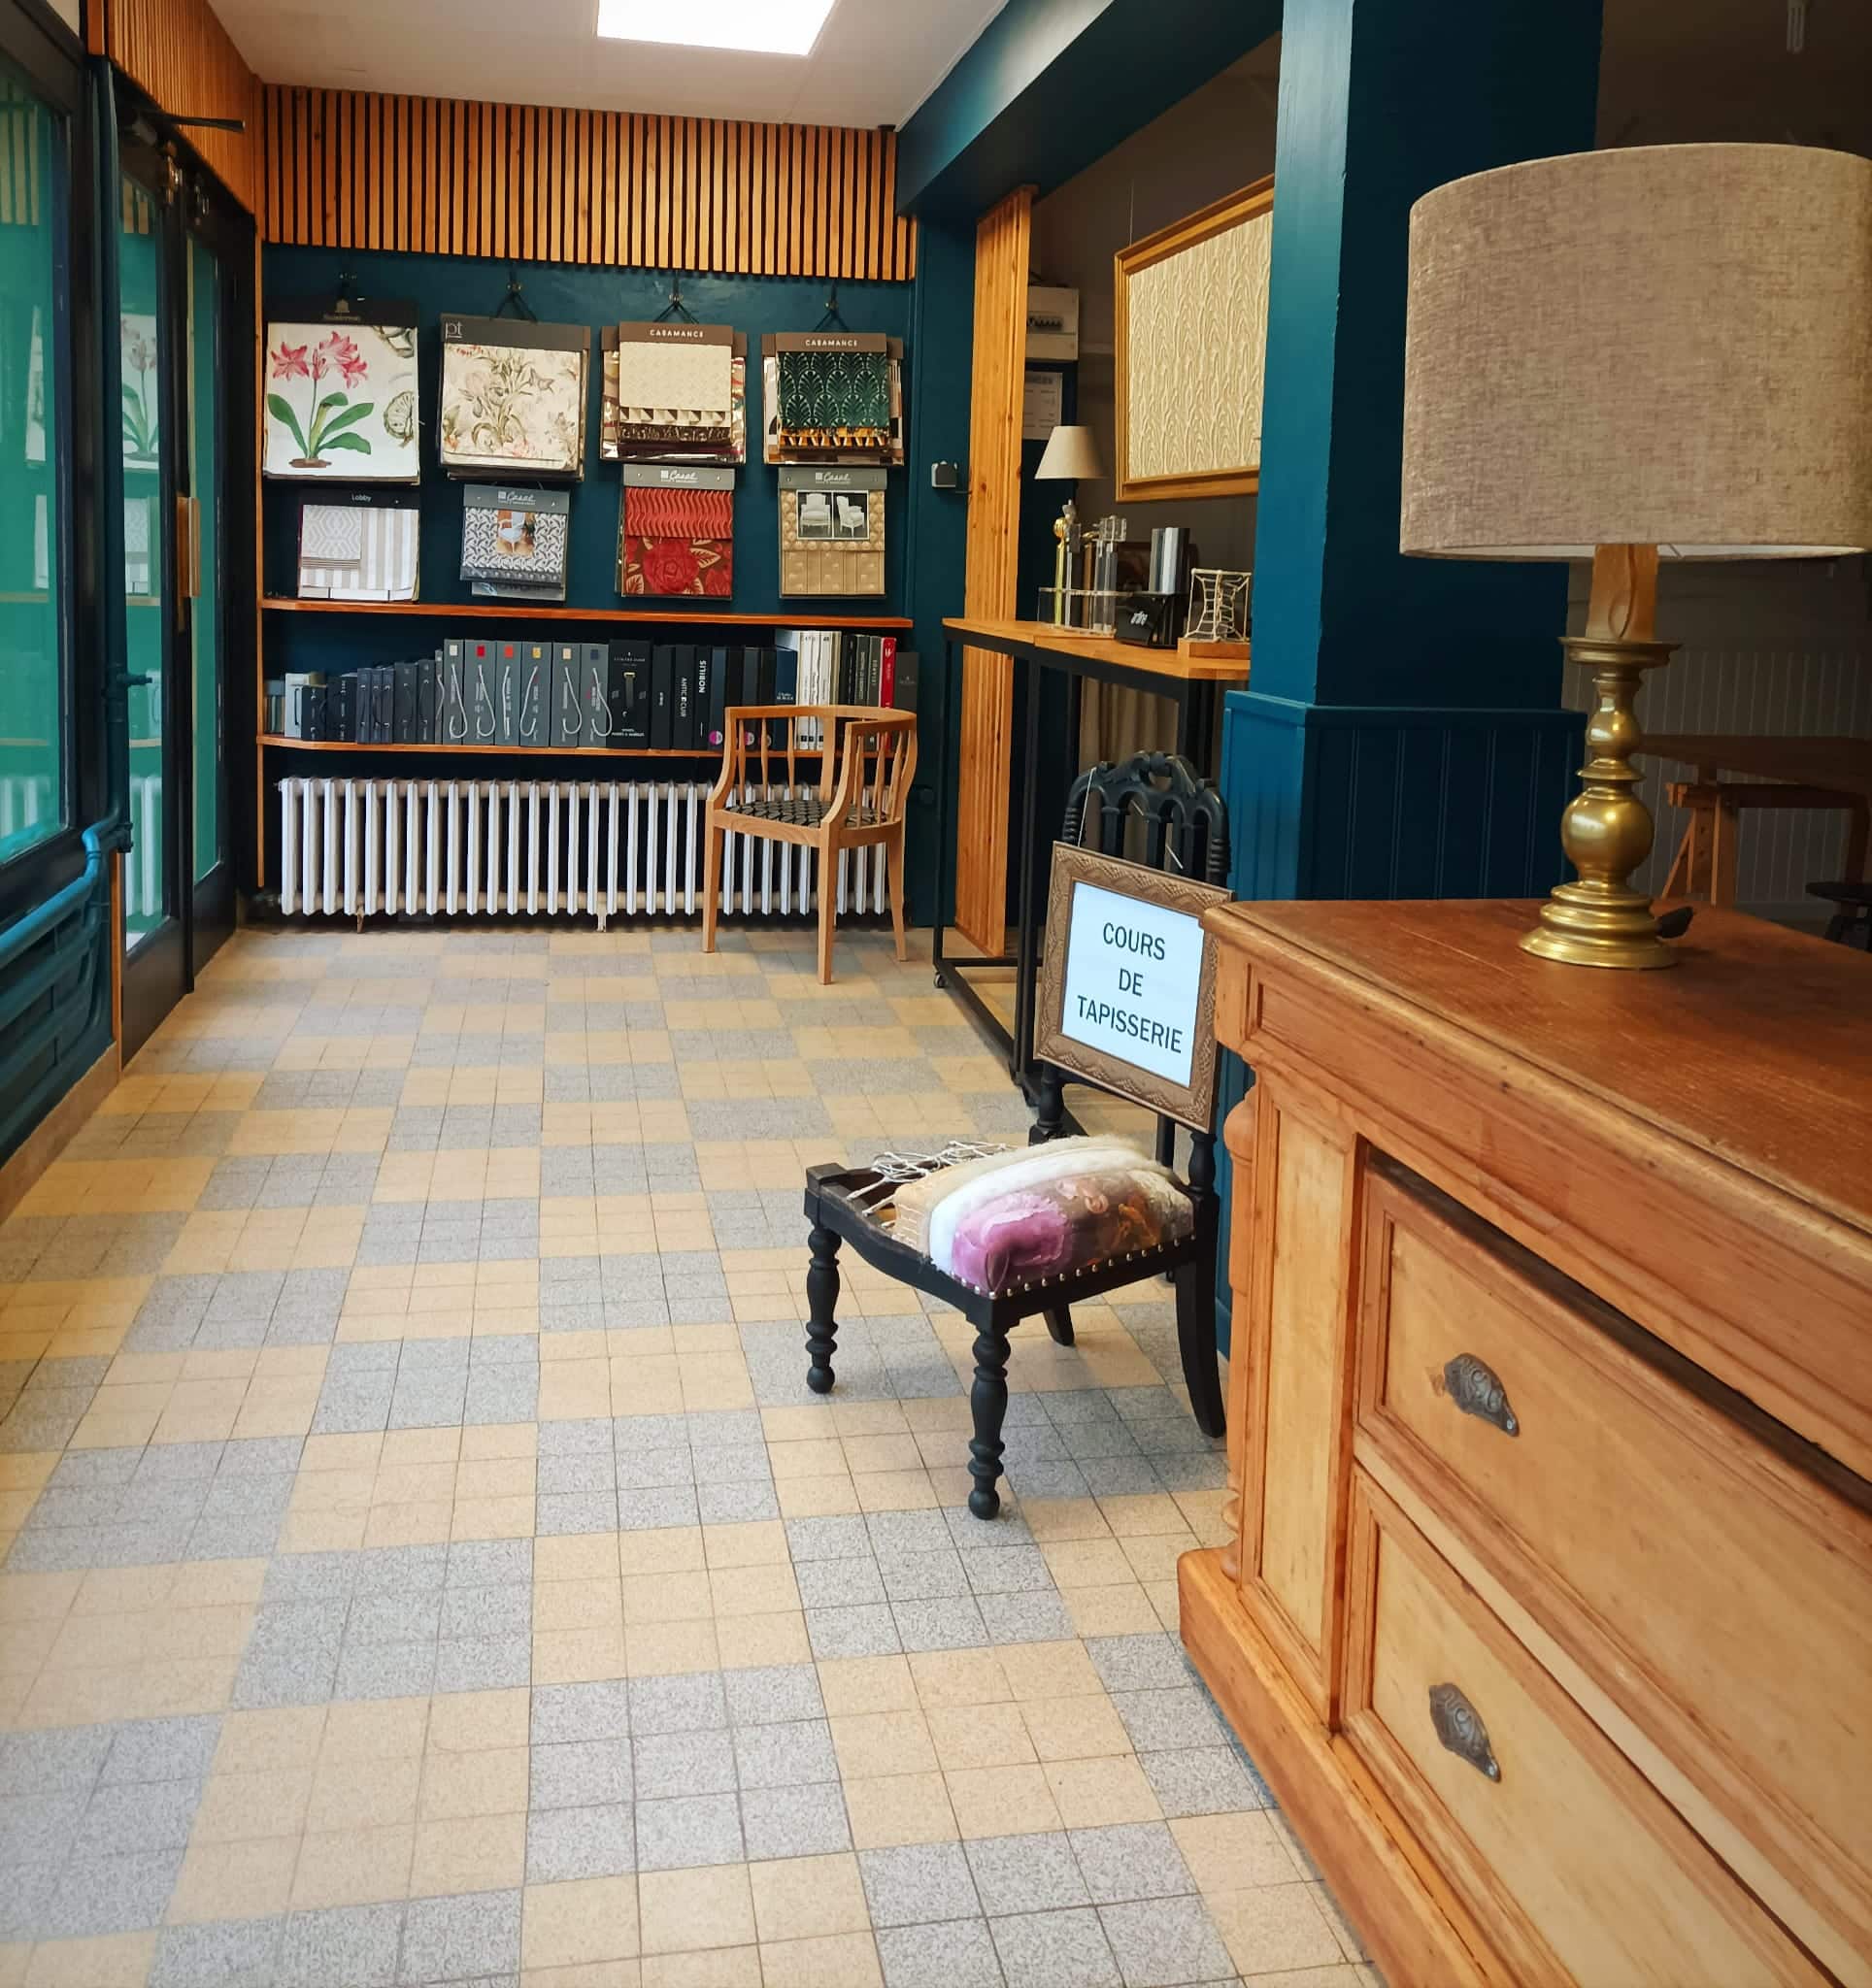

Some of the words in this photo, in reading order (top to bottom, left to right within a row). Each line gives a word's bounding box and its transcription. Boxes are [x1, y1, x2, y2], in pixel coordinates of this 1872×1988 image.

[650, 329, 704, 338] CASAMANCE
[351, 492, 372, 503] Lobby
[698, 659, 707, 693] NOBILIS
[1102, 922, 1166, 961] COURS
[1118, 968, 1144, 997] DE
[1077, 995, 1184, 1054] TAPISSERIE
